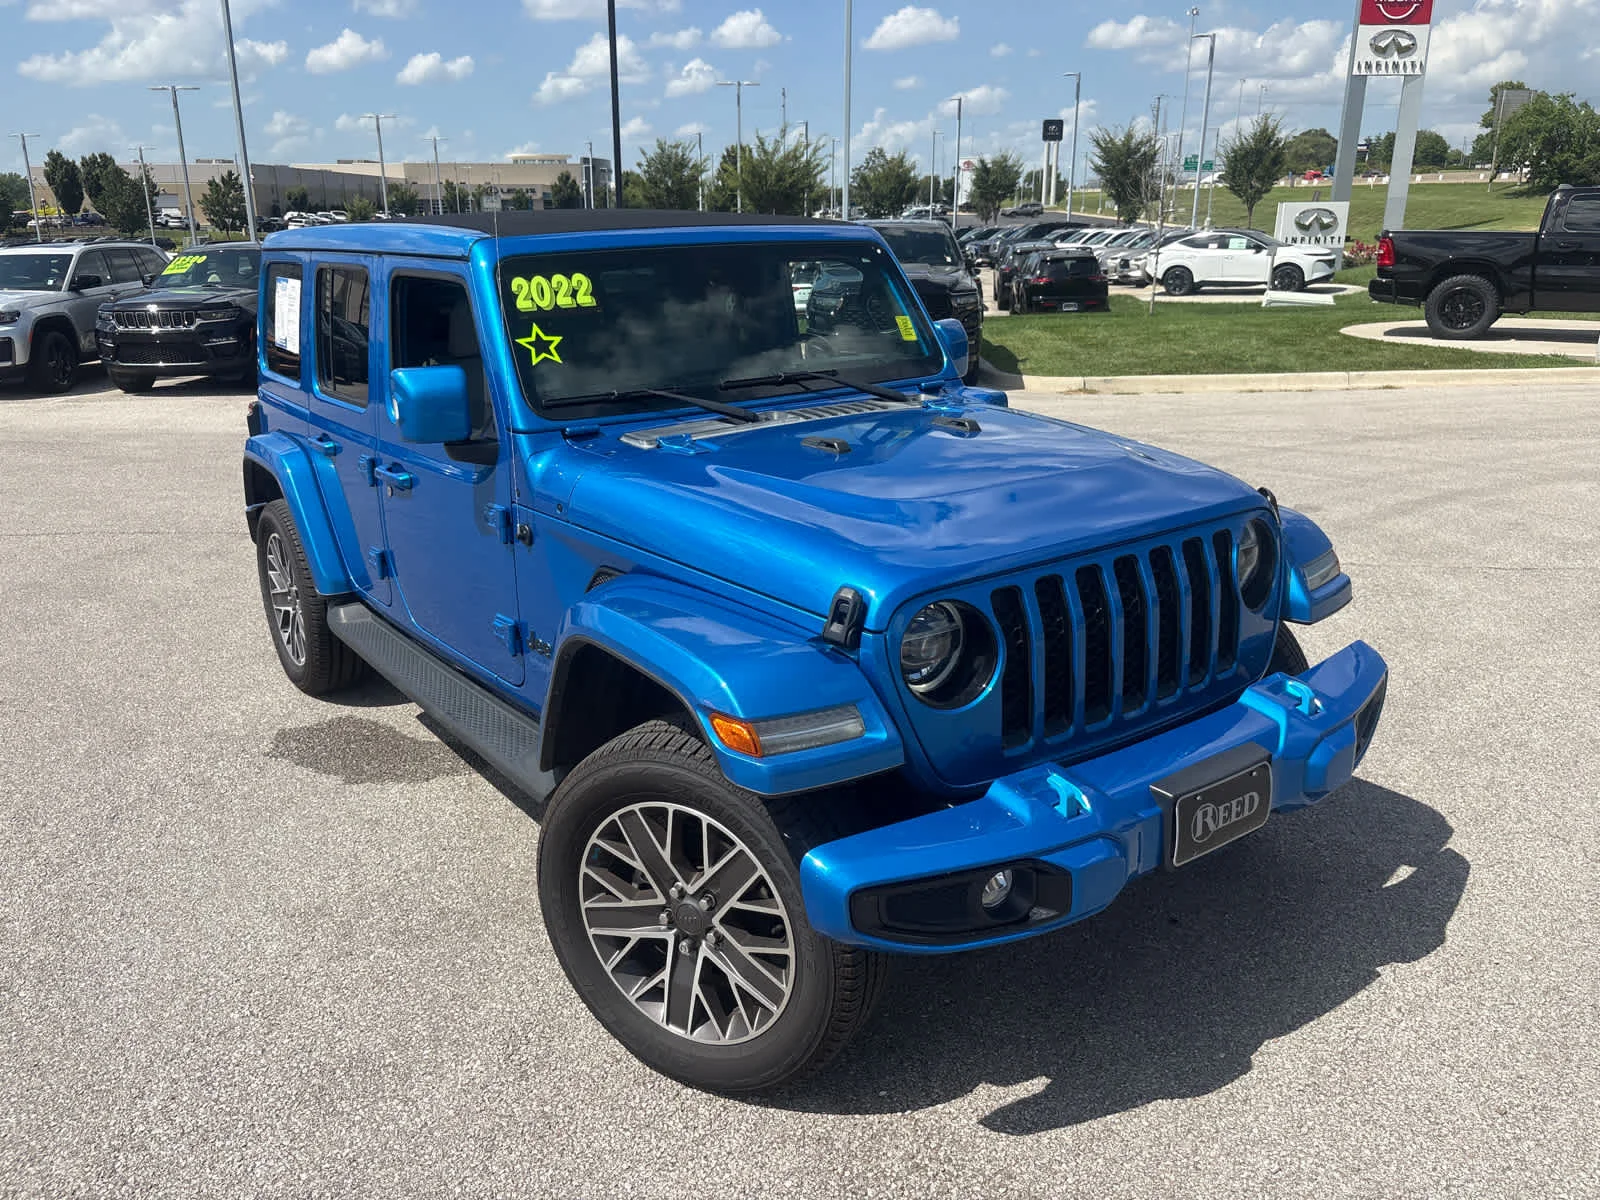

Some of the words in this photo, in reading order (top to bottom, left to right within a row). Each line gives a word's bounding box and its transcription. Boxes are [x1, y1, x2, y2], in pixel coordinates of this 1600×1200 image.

[1357, 60, 1425, 74] INFINITI
[1285, 236, 1342, 245] INFINITI
[511, 273, 597, 312] 2022
[1192, 792, 1260, 843] REED
